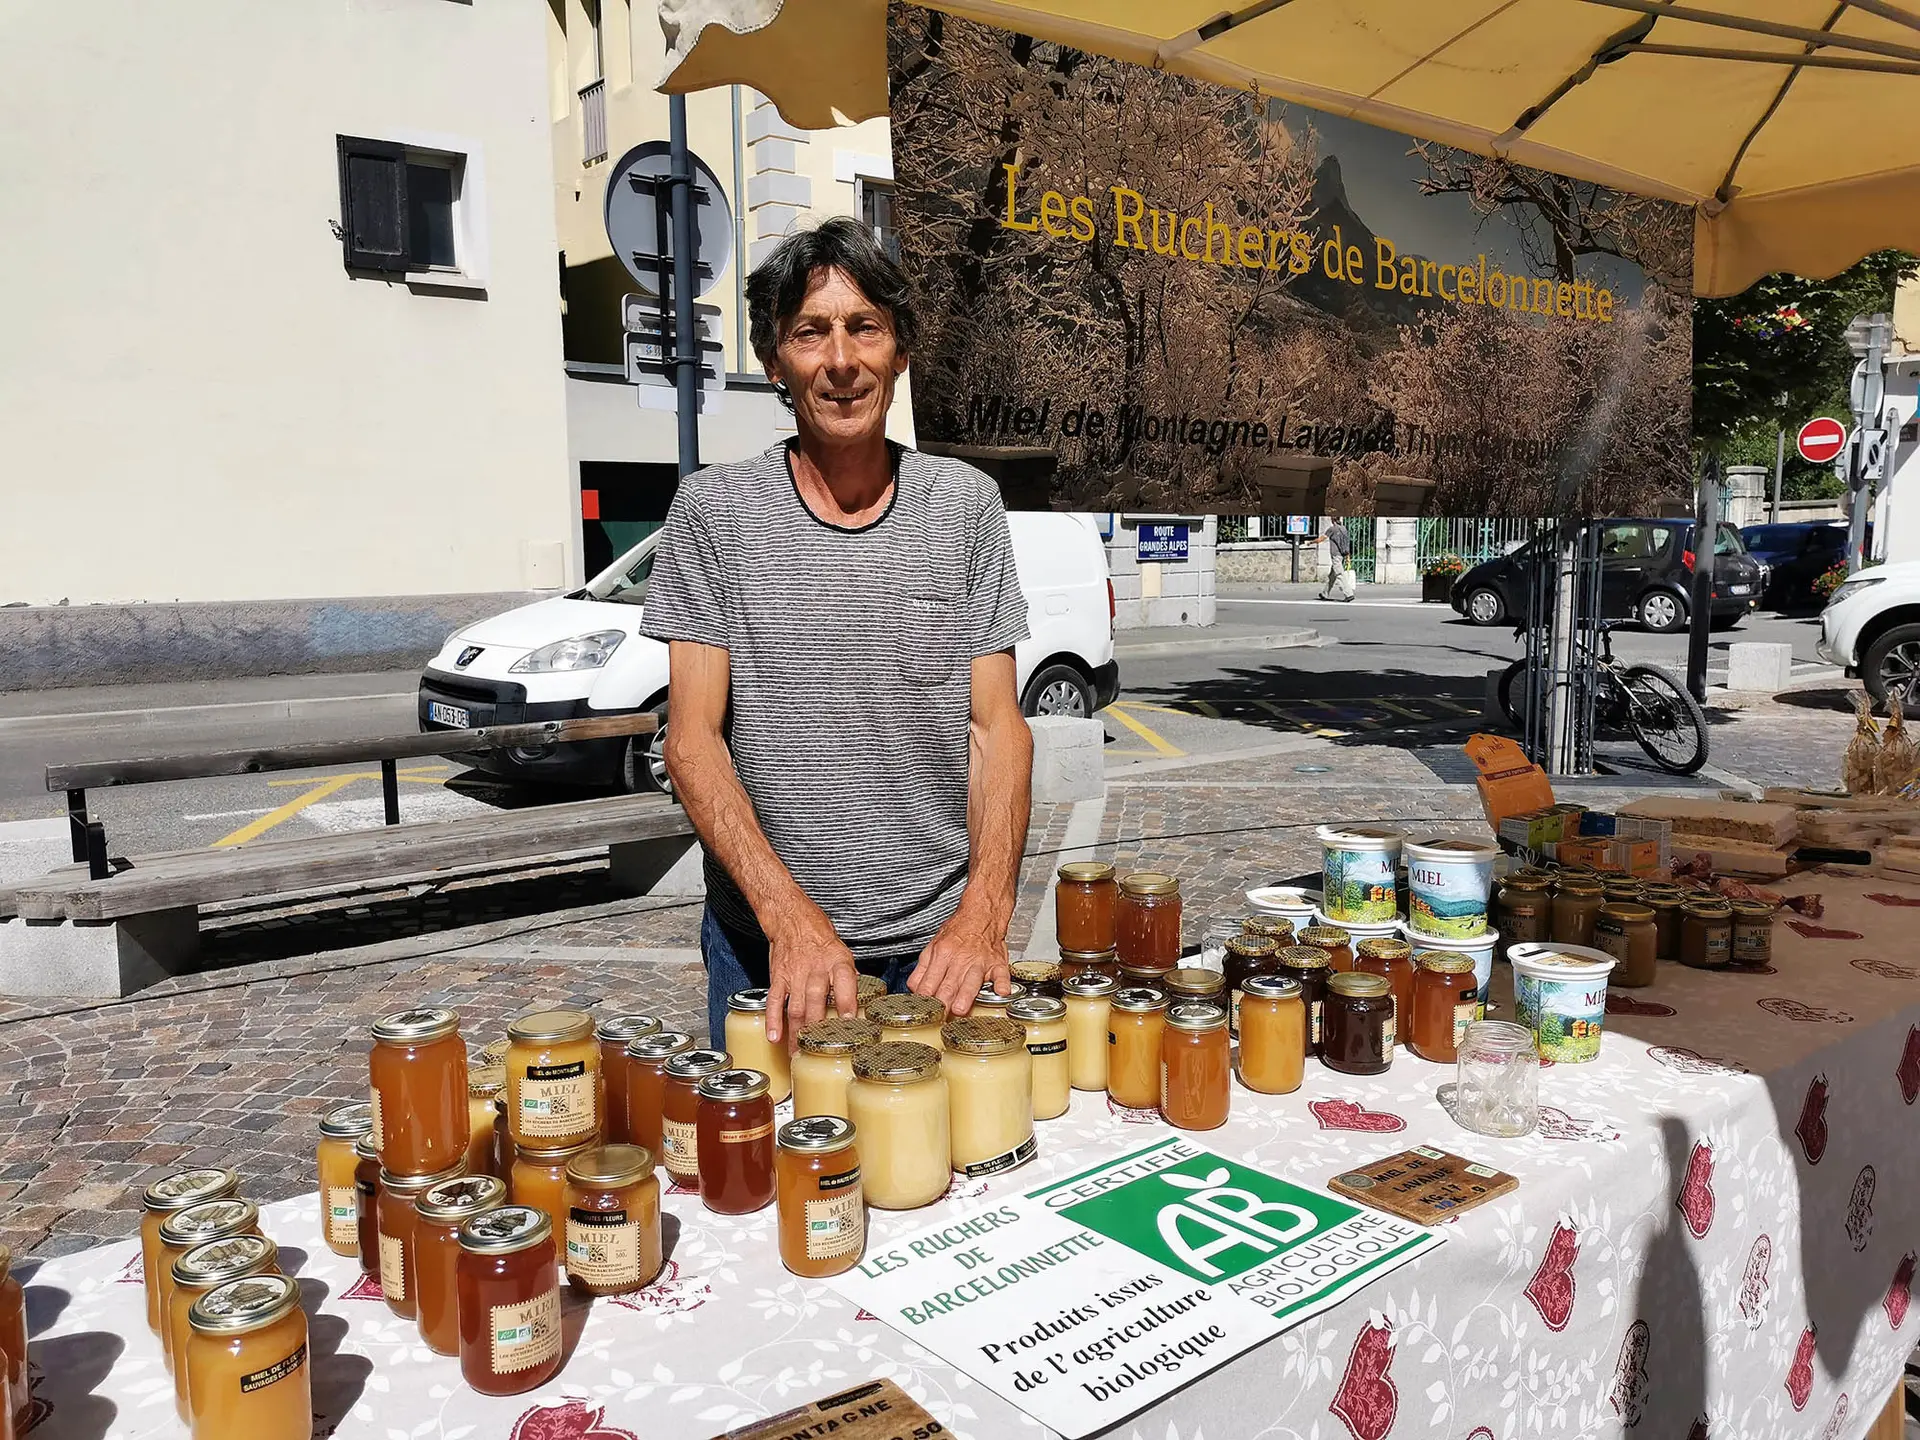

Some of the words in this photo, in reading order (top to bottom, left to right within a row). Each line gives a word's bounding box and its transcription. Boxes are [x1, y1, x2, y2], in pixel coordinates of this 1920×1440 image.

[1002, 163, 1096, 242] Les
[1111, 185, 1311, 275] Ruchers
[1323, 225, 1365, 285] de
[1374, 235, 1614, 323] Barcelonnette
[967, 394, 1051, 437] Miel
[1060, 398, 1105, 440] de
[1153, 525, 1175, 537] ROUTE
[1139, 540, 1168, 552] GRANDES
[1168, 540, 1188, 551] ALPES
[1411, 867, 1446, 887] MIEL
[540, 1084, 581, 1097] MIEL
[1044, 1144, 1200, 1208] CERTIFIÉ
[1373, 1168, 1407, 1184] MIEL
[1405, 1160, 1426, 1170] DE
[1392, 1166, 1454, 1193] LAVANDE
[602, 1214, 624, 1222] FLEURS
[580, 1232, 620, 1245] MIEL
[857, 1250, 909, 1279] LES
[907, 1205, 1021, 1259] RUCHERS
[1156, 1187, 1319, 1279] AB
[953, 1246, 995, 1270] DE
[1227, 1213, 1387, 1296] AGRICULTURE
[1250, 1223, 1414, 1309] BIOLOGIQUE
[899, 1231, 1104, 1326] BARCELONNETTE
[977, 1303, 1100, 1364] Produits
[1094, 1273, 1164, 1309] issus
[250, 1371, 271, 1382] MIEL
[271, 1364, 283, 1374] DE
[1080, 1323, 1227, 1402] biologique
[243, 1376, 278, 1391] SAUVAGES
[1012, 1370, 1049, 1393] de
